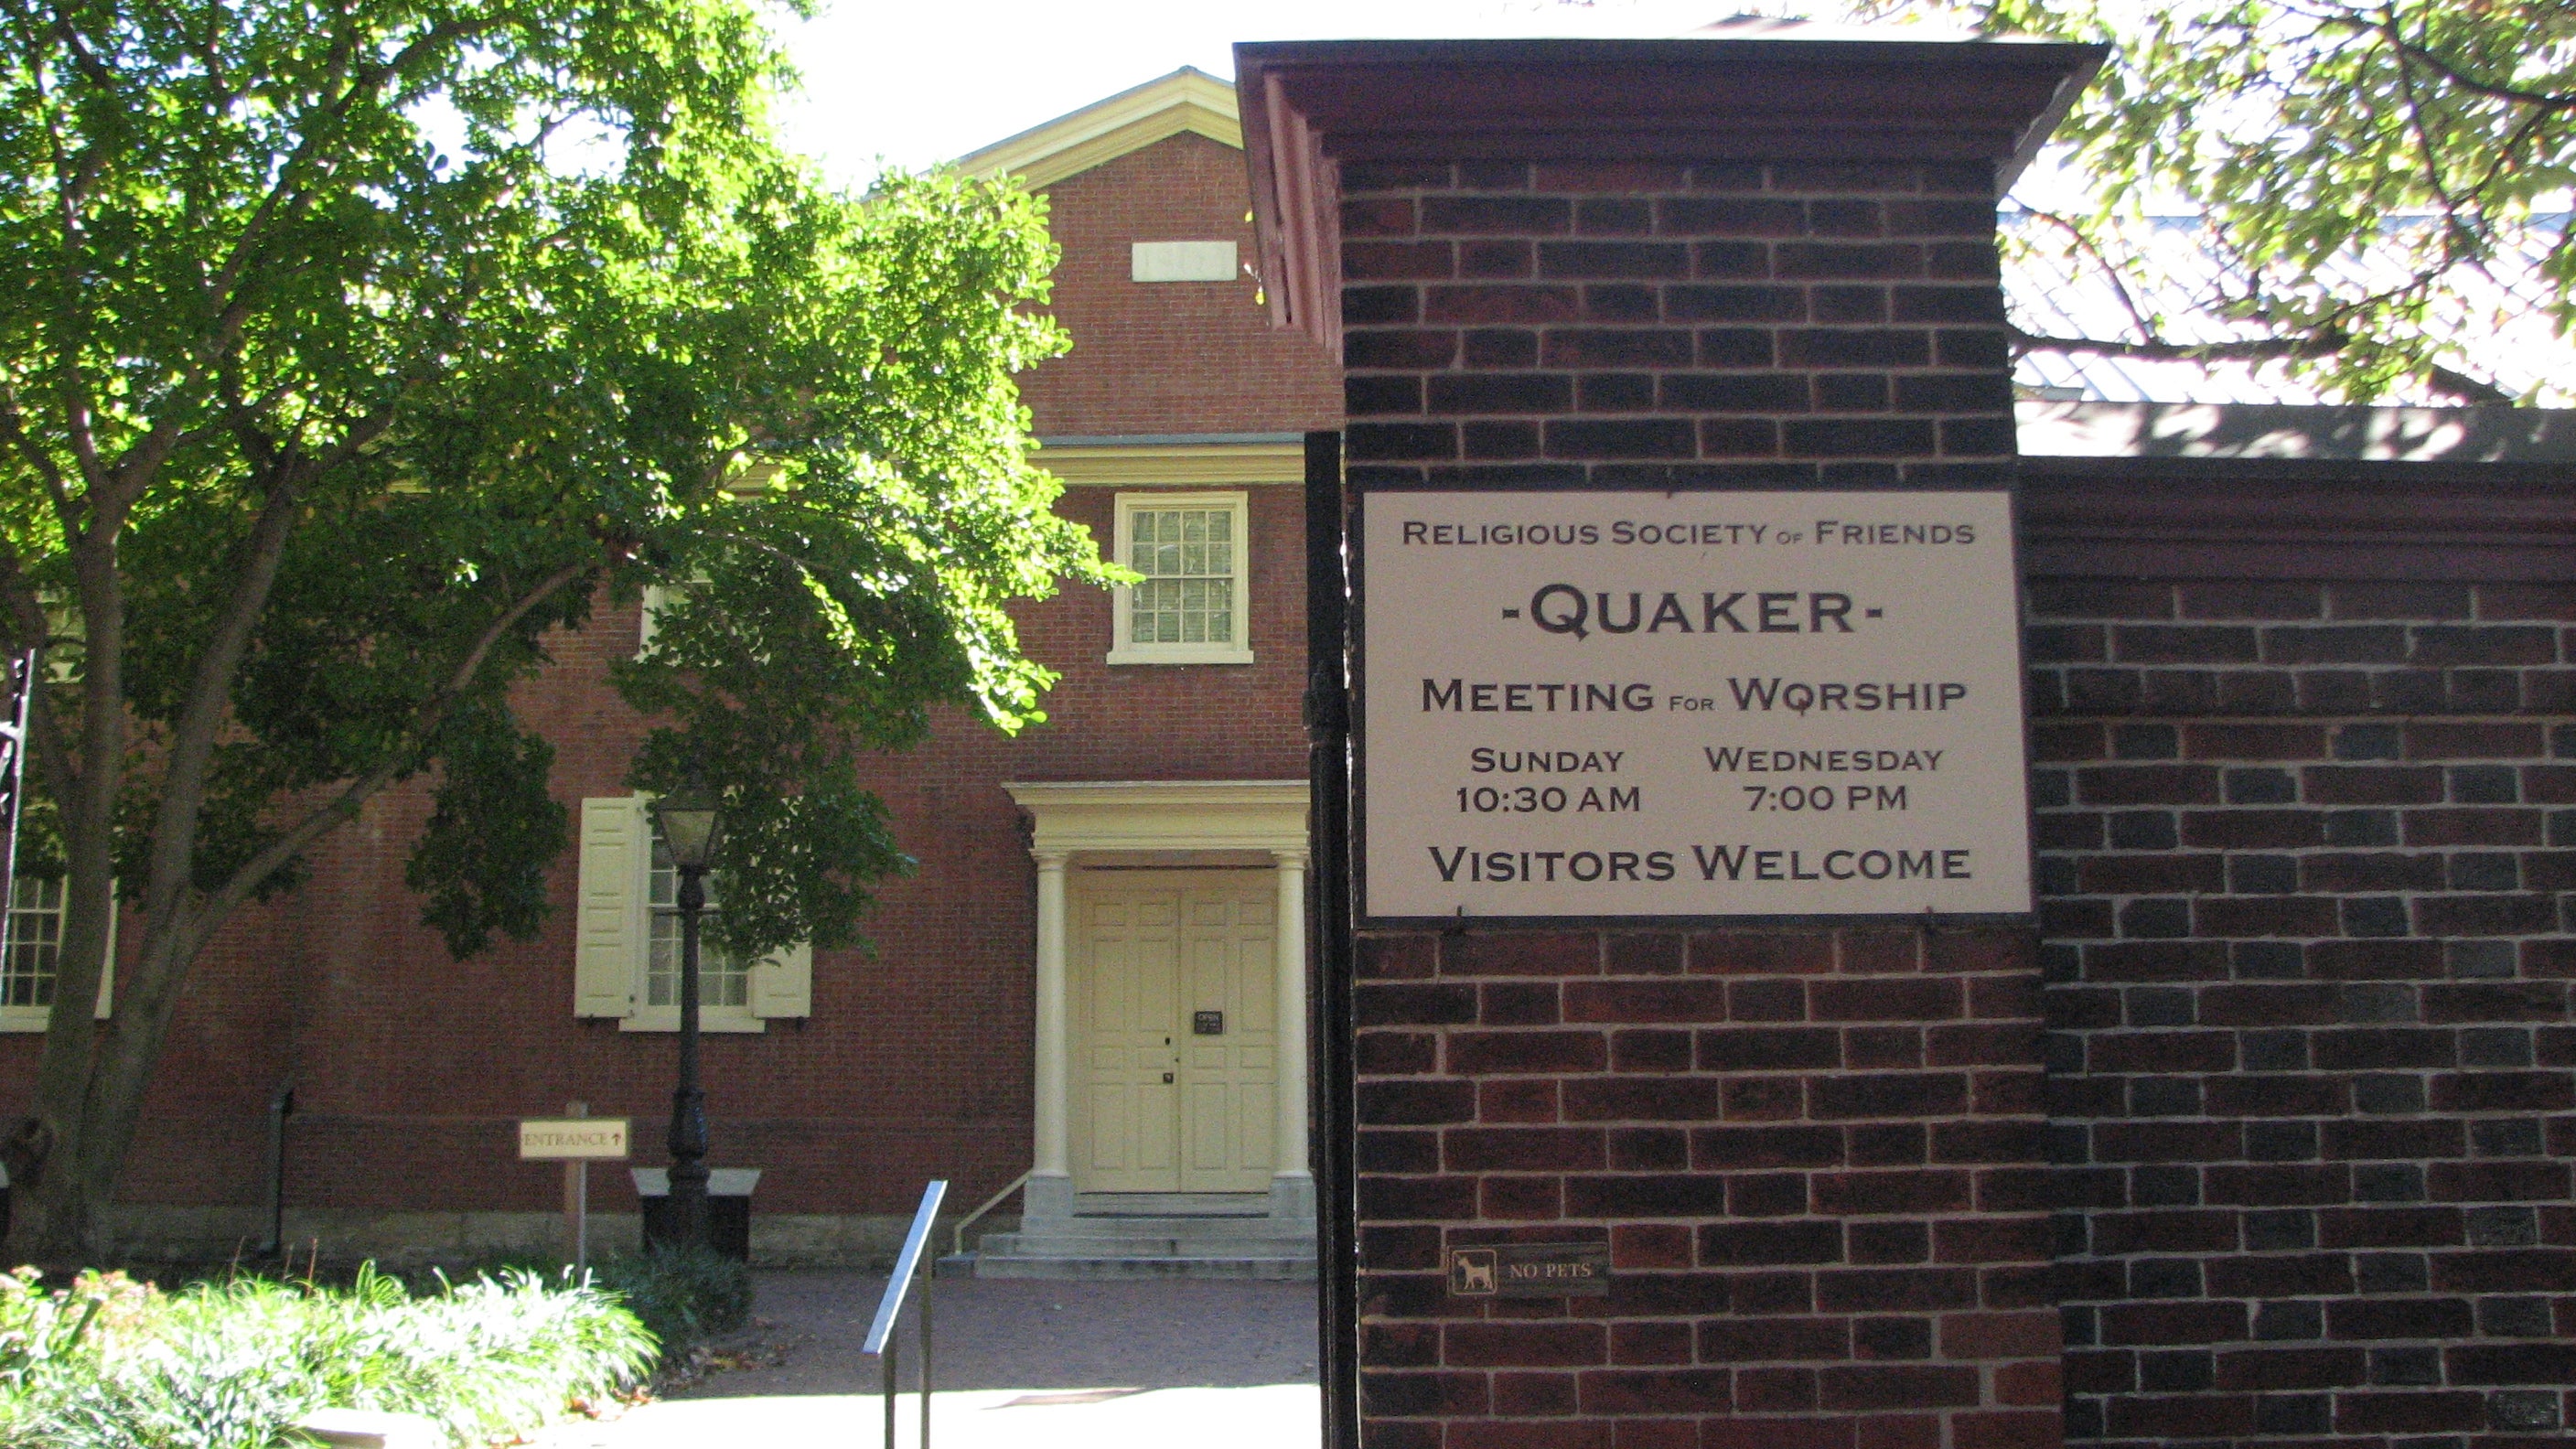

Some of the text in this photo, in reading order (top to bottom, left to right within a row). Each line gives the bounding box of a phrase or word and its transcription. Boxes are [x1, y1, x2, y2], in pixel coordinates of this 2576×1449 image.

[1402, 520, 1976, 545] RELIGIOUS SOCIETY OF FRIENDS
[1422, 677, 1968, 717] MEETING FOR WORSHIP
[1470, 746, 1625, 774] SUNDAY
[1703, 746, 1945, 773] WEDNESDAY
[1456, 786, 1640, 813] 10:30 AM
[1743, 785, 1907, 812] 7:00 PM
[1427, 844, 1972, 883] VISITORS WELCOME
[524, 1133, 606, 1146] ENTRANCE
[1510, 1262, 1592, 1278] NO PETS
